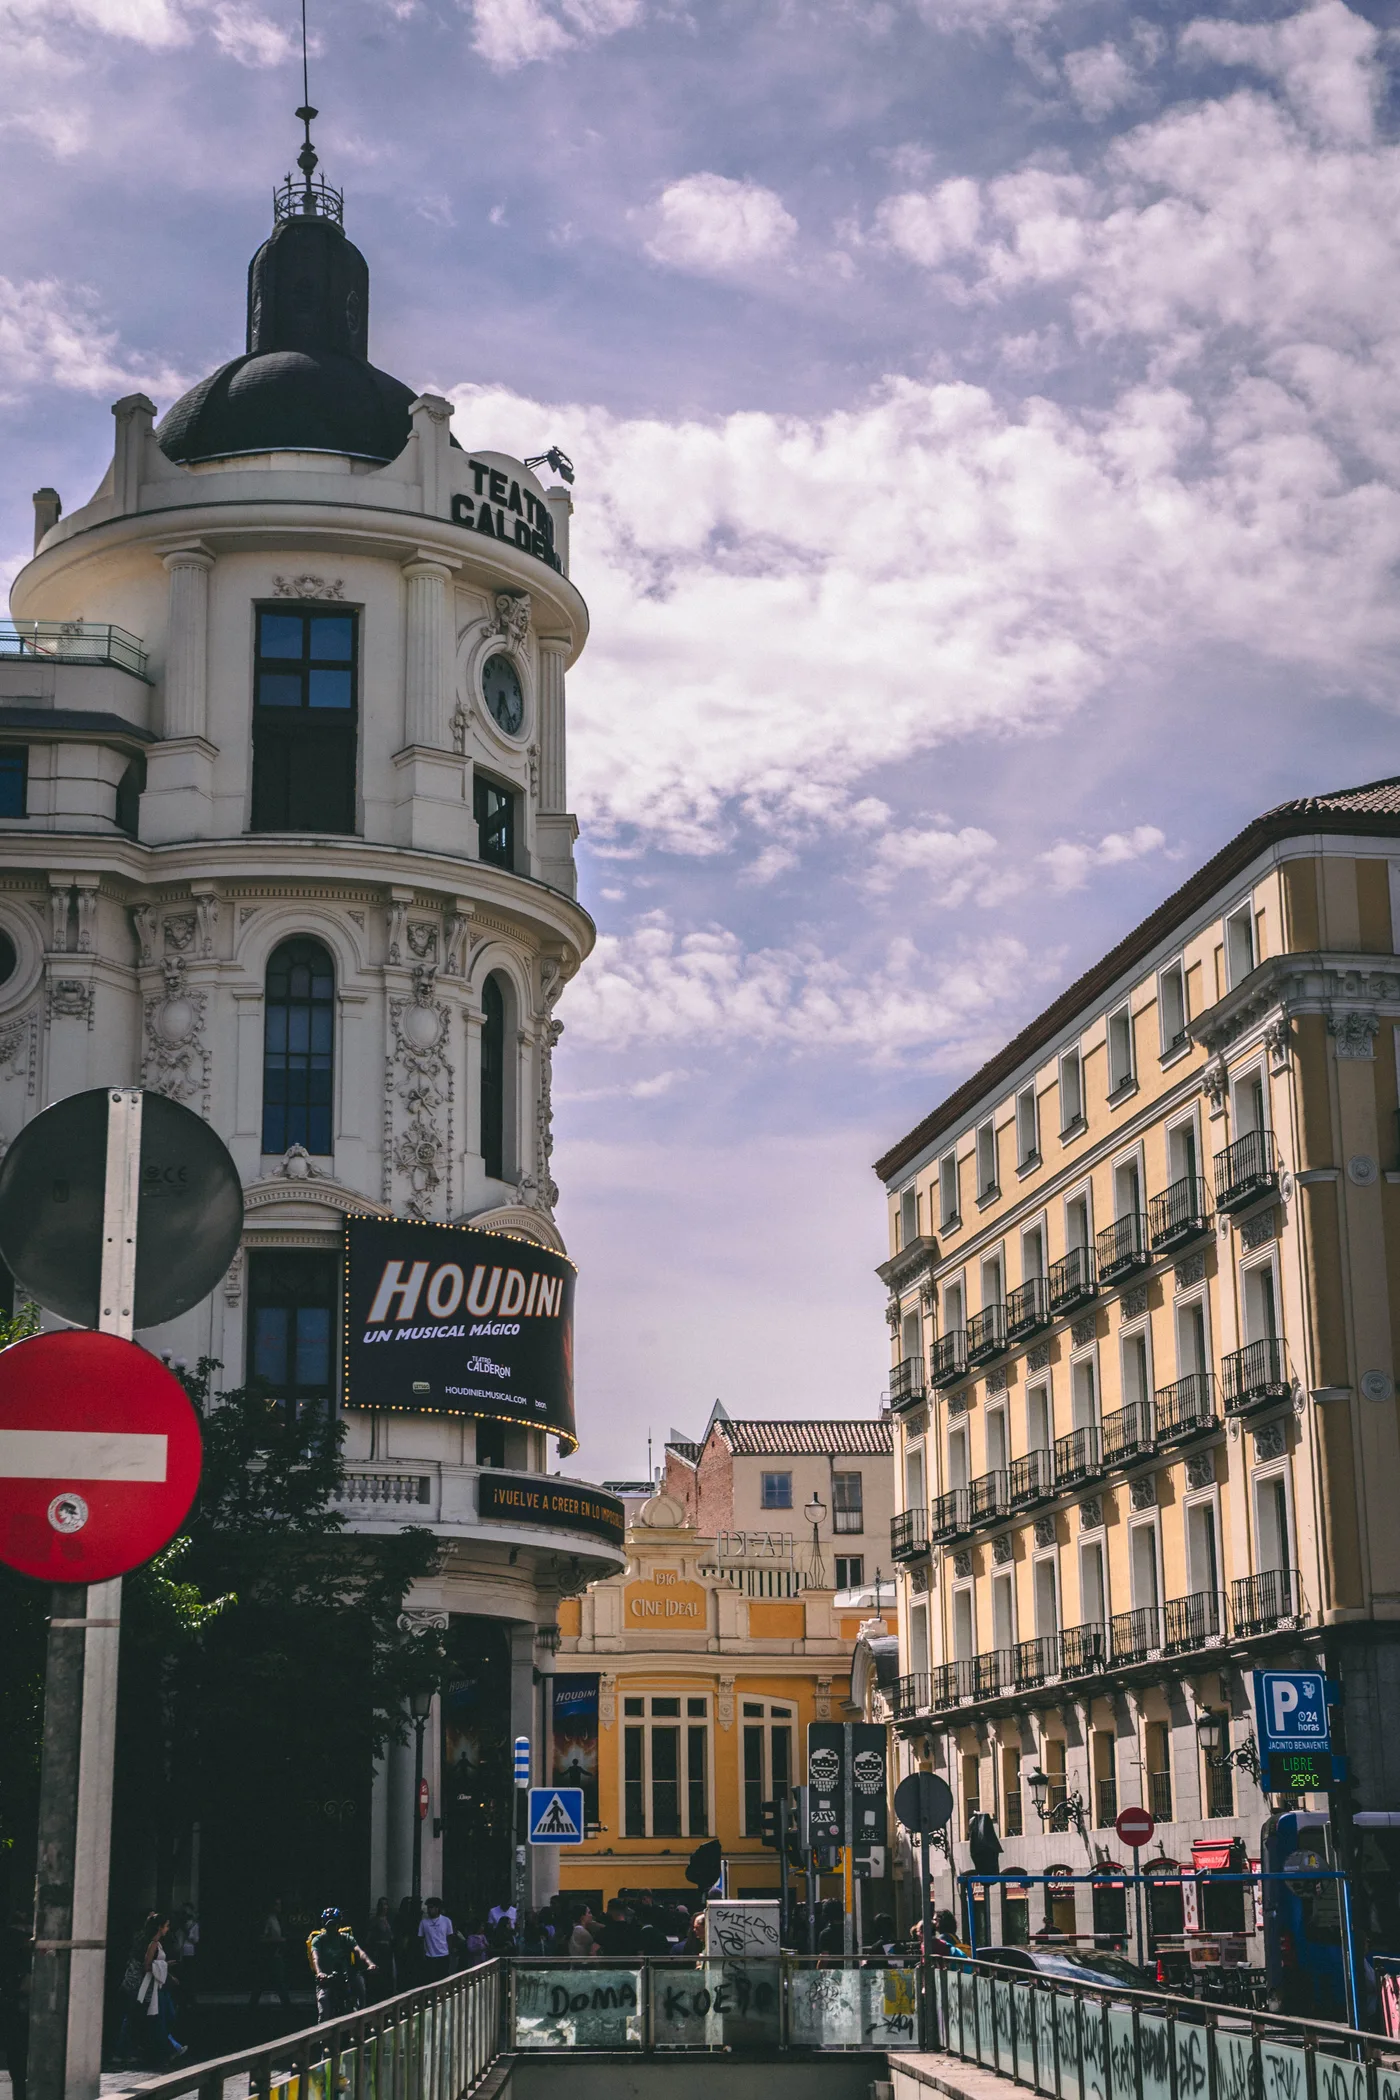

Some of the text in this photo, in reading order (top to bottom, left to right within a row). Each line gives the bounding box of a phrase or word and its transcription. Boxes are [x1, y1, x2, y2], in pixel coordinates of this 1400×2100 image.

[366, 1260, 564, 1325] HOUDINI
[363, 1320, 521, 1344] UN MUSICAL MÁGICO
[542, 1495, 549, 1510] A
[552, 1496, 579, 1515] CREER
[581, 1501, 590, 1517] EN
[592, 1505, 600, 1520] LO
[655, 1573, 676, 1586] 1916
[556, 1690, 596, 1702] HOUDINI
[1272, 1681, 1299, 1731] P
[1306, 1711, 1318, 1722] 24
[1298, 1722, 1320, 1731] horas
[1268, 1741, 1329, 1750] JACINTO BENAVENTE
[1283, 1757, 1314, 1771] LIBRE
